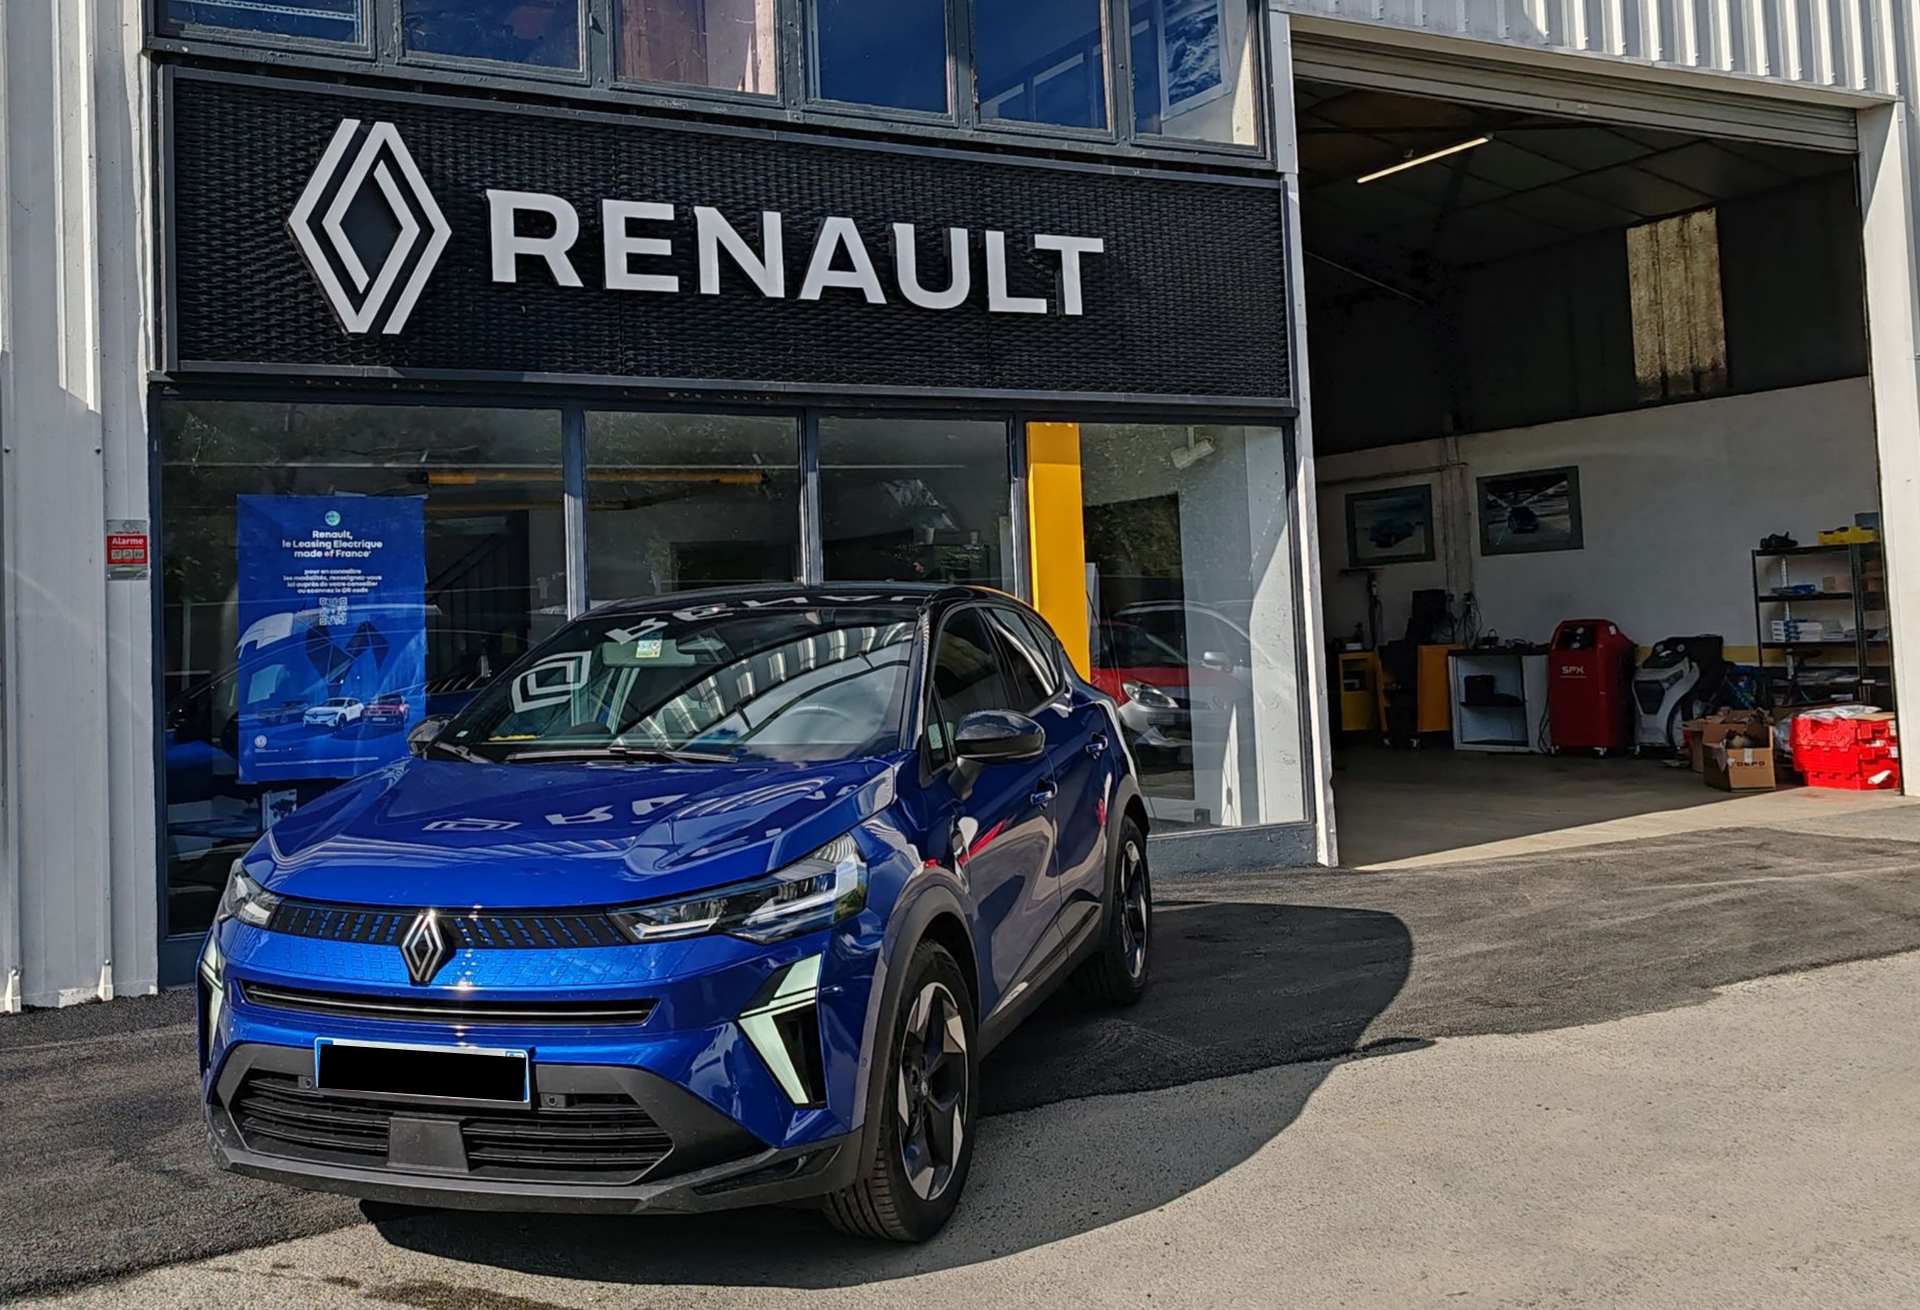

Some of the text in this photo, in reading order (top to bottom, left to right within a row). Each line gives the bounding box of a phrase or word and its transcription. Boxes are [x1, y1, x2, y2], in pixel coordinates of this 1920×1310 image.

[486, 188, 1105, 316] RENAULT
[312, 530, 353, 540] Renault,
[112, 537, 144, 545] Alarme
[282, 540, 291, 548] le
[293, 540, 332, 550] Leasing
[294, 550, 323, 558] made
[1561, 665, 1585, 674] SPX
